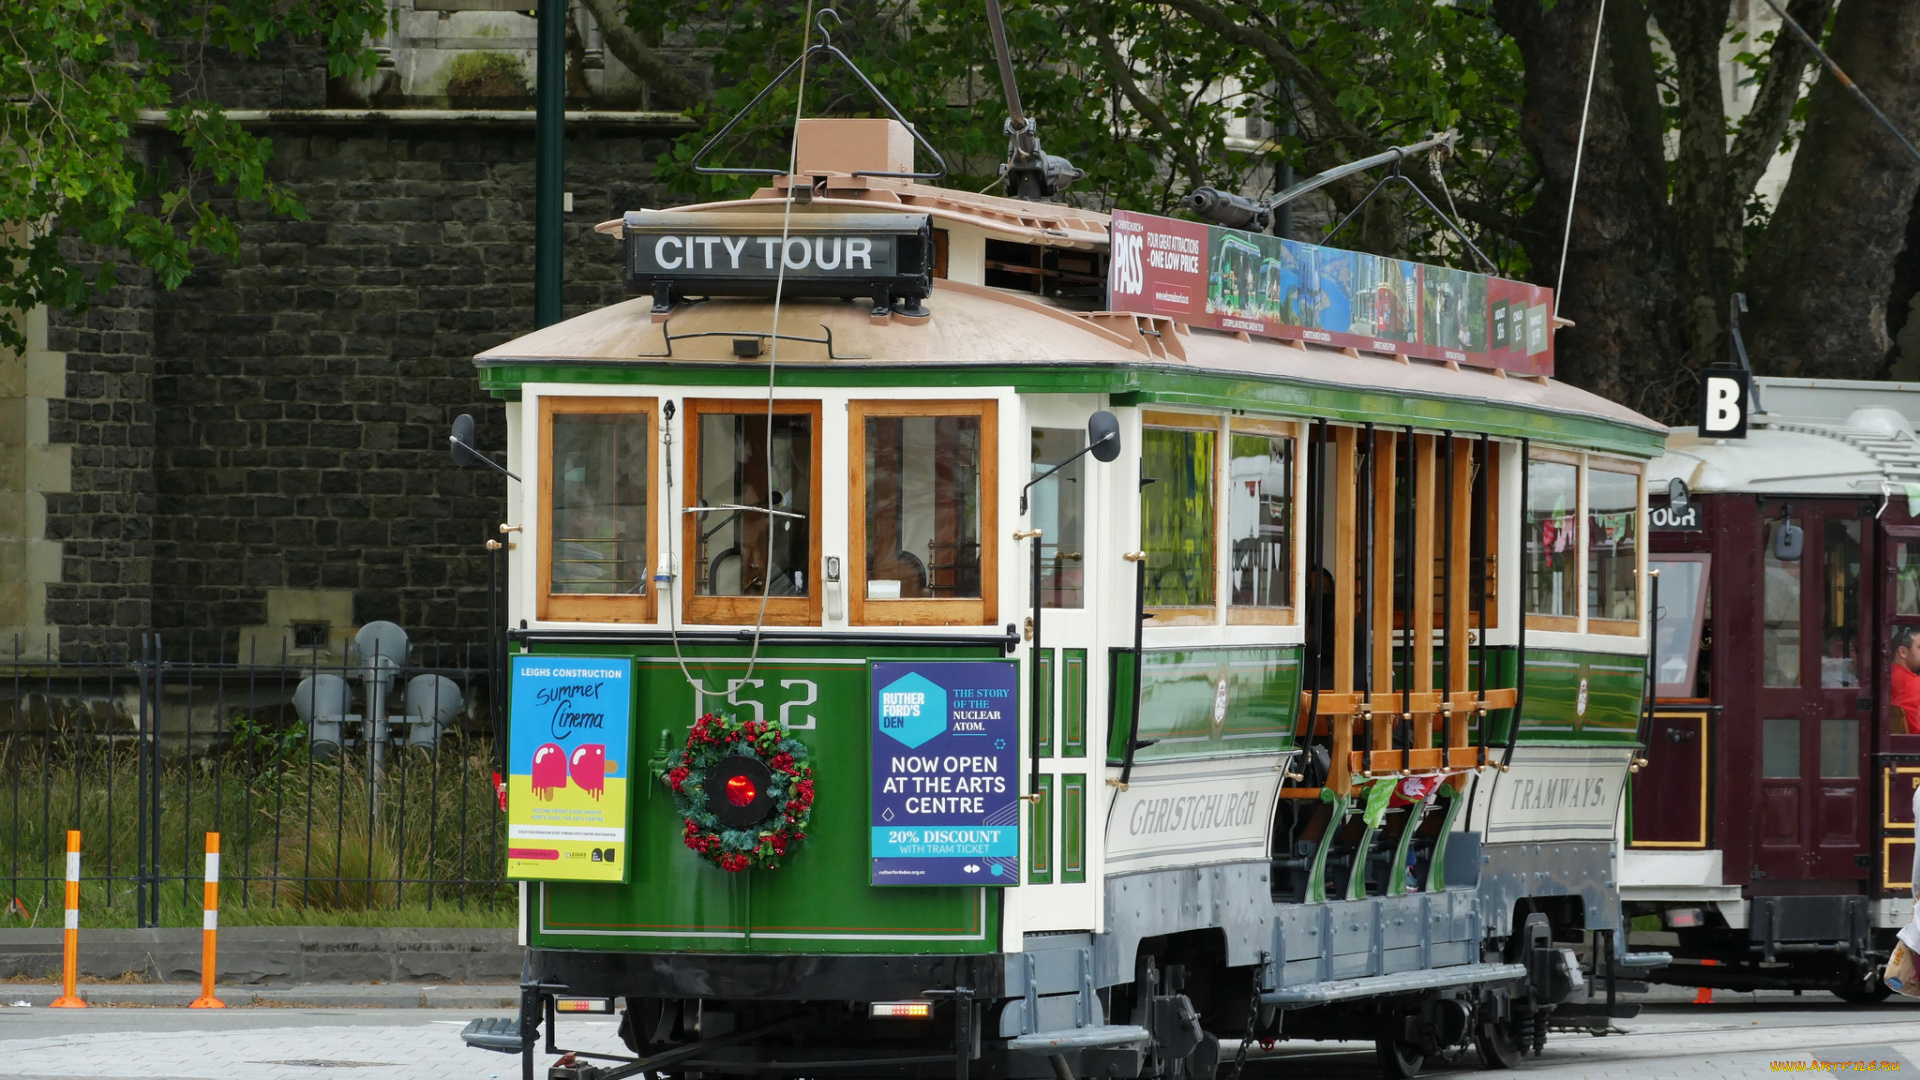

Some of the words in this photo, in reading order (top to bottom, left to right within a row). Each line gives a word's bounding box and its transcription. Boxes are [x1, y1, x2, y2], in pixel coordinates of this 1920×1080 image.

[1147, 232, 1158, 248] FOUR
[1159, 233, 1171, 250] GREAT
[1172, 236, 1199, 254] ATTRACTIONS
[654, 236, 748, 270] CITY
[757, 236, 872, 270] TOUR
[1150, 249, 1164, 268] ONE
[1165, 252, 1180, 270] LOW
[1180, 254, 1199, 274] PRICE
[1114, 232, 1144, 295] PASS
[1706, 377, 1740, 432] B
[1648, 508, 1696, 526] OUR
[522, 668, 550, 677] LEIGHS
[553, 669, 622, 678] CONSTRUCTION
[536, 682, 604, 706] Summer
[883, 692, 925, 704] RUTHER
[953, 689, 974, 698] THE
[977, 689, 1009, 698] STORY
[686, 679, 818, 730] 152
[883, 705, 920, 717] FORD'S
[953, 700, 967, 709] OF
[968, 700, 989, 708] THE
[551, 699, 604, 740] Cinema
[884, 717, 904, 728] DEN
[953, 711, 1001, 720] NUCLEAR
[953, 722, 985, 731] ATOM.
[892, 756, 939, 773] NOW
[944, 756, 997, 773] OPEN
[883, 777, 908, 793] AT
[912, 777, 951, 793] THE
[955, 776, 1006, 793] ARTS
[906, 797, 984, 814] CENTRE
[1130, 790, 1259, 836] CHRISTCHURCH
[889, 830, 920, 843] 20%
[924, 830, 1001, 843] DISCOUNT
[900, 844, 924, 854] WITH
[928, 844, 954, 853] TRAM
[957, 844, 990, 854] TICKET
